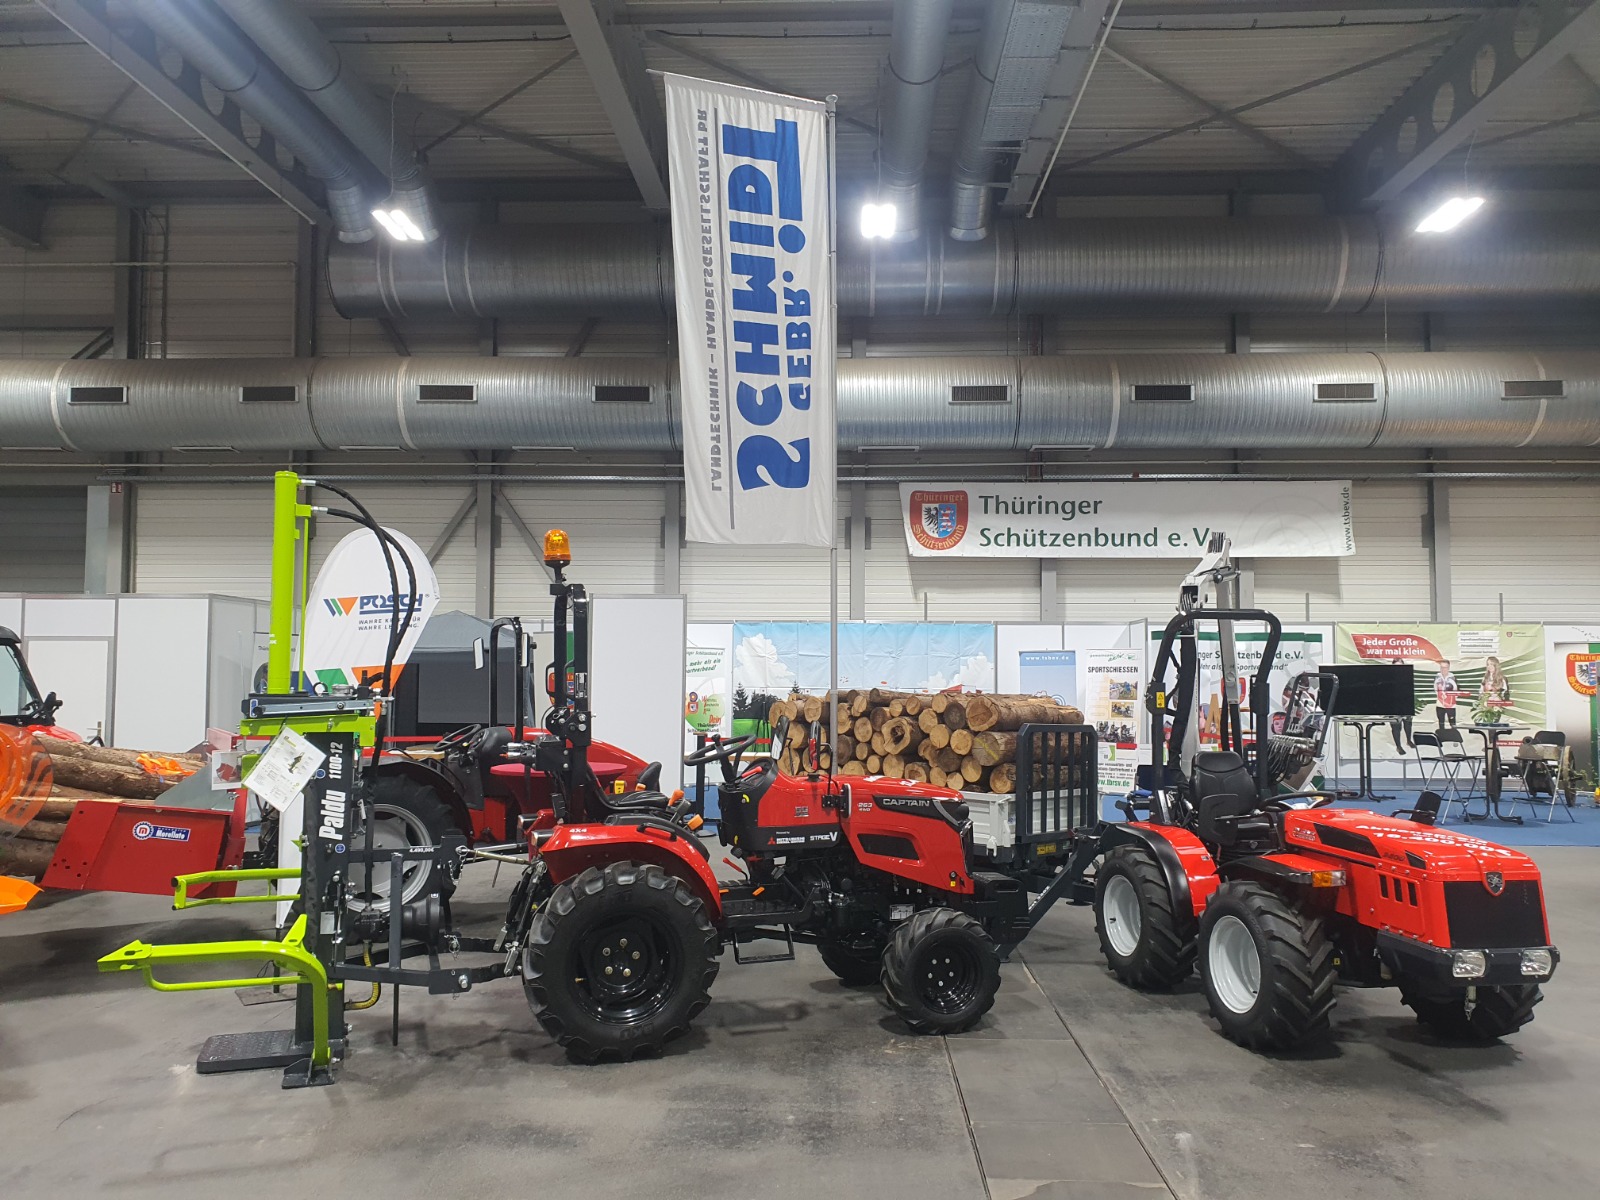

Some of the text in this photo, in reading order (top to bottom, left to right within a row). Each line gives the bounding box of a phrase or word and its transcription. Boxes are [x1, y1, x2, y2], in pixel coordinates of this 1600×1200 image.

[978, 494, 1103, 521] Thüringer
[1340, 486, 1352, 551] www.tsbev.de
[979, 526, 1158, 548] Schützenbund
[1362, 637, 1418, 646] Jeder Große
[1284, 650, 1304, 660] e.V.
[1087, 666, 1139, 674] SPORTSCHIESSEN
[329, 741, 344, 780] 1100-12
[882, 798, 930, 807] CAPTAIN
[319, 789, 346, 841] Paldu
